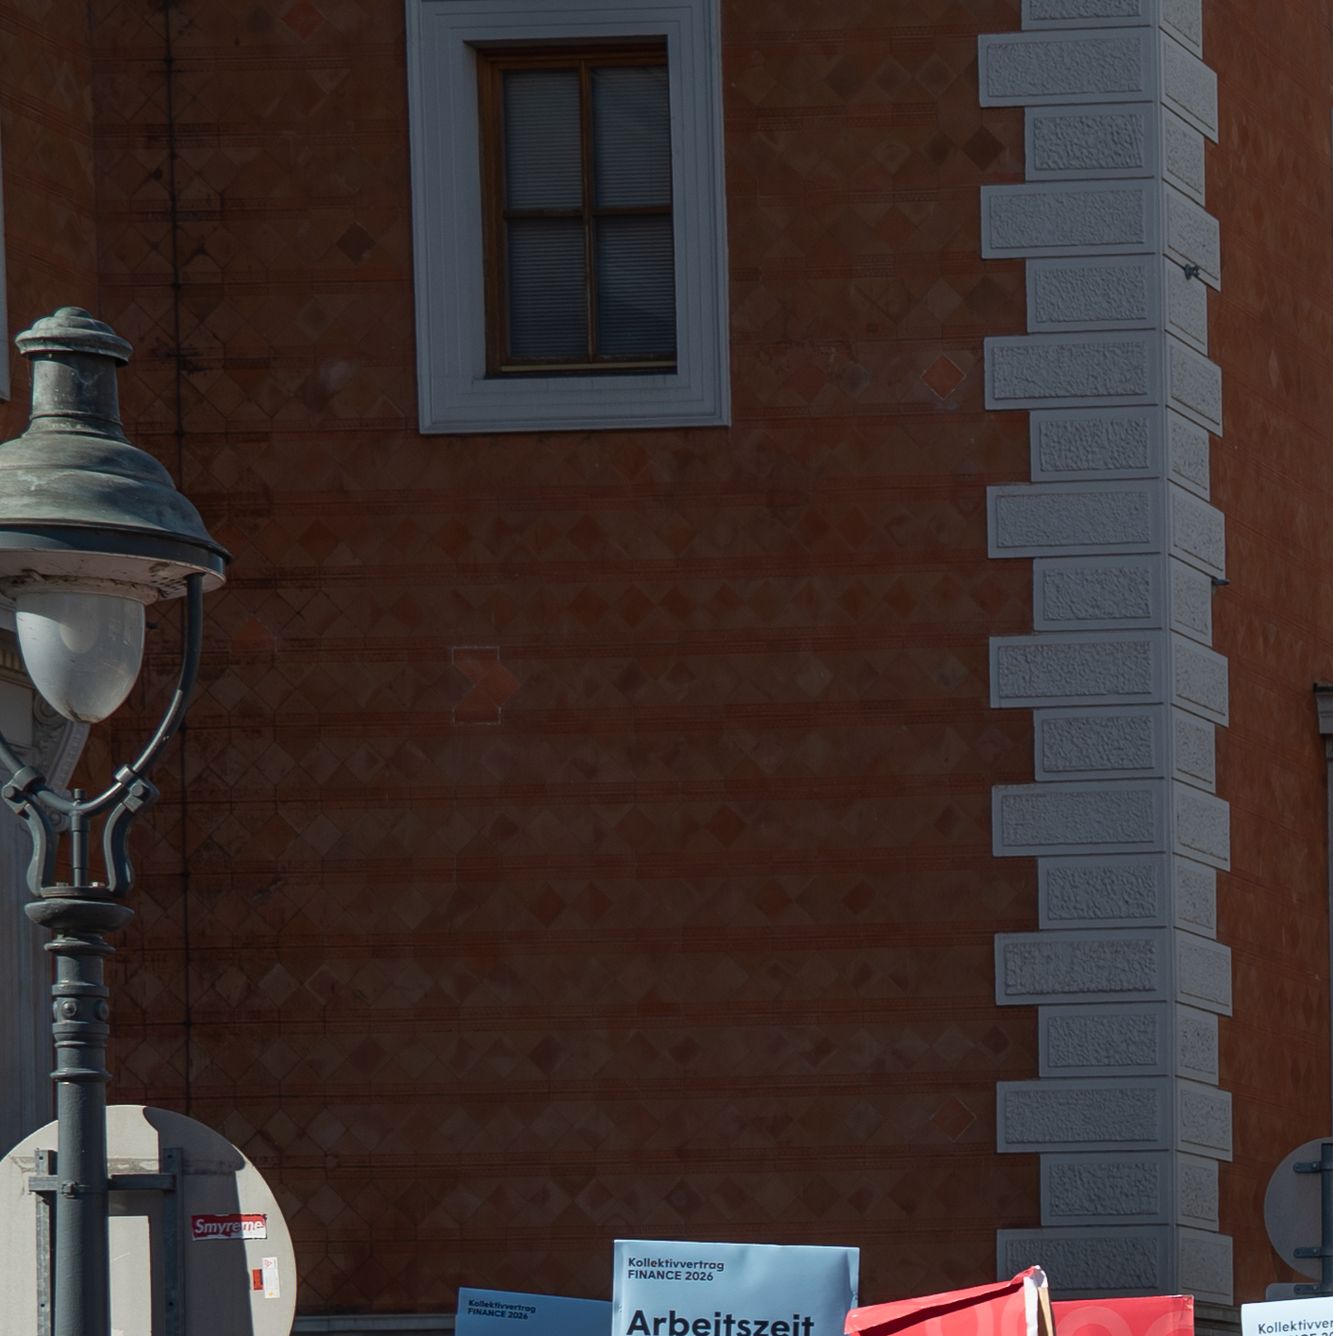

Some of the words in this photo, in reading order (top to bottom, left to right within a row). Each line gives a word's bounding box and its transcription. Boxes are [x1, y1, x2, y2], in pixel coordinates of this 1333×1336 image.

[194, 1218, 264, 1235] Smyreme
[628, 1257, 725, 1272] Kollektivvertrag
[628, 1270, 682, 1281] FINANCE
[685, 1271, 714, 1281] 2026
[467, 1308, 506, 1319] FINANCE
[507, 1311, 529, 1320] 2026
[468, 1299, 536, 1314] Kollektivvertrag
